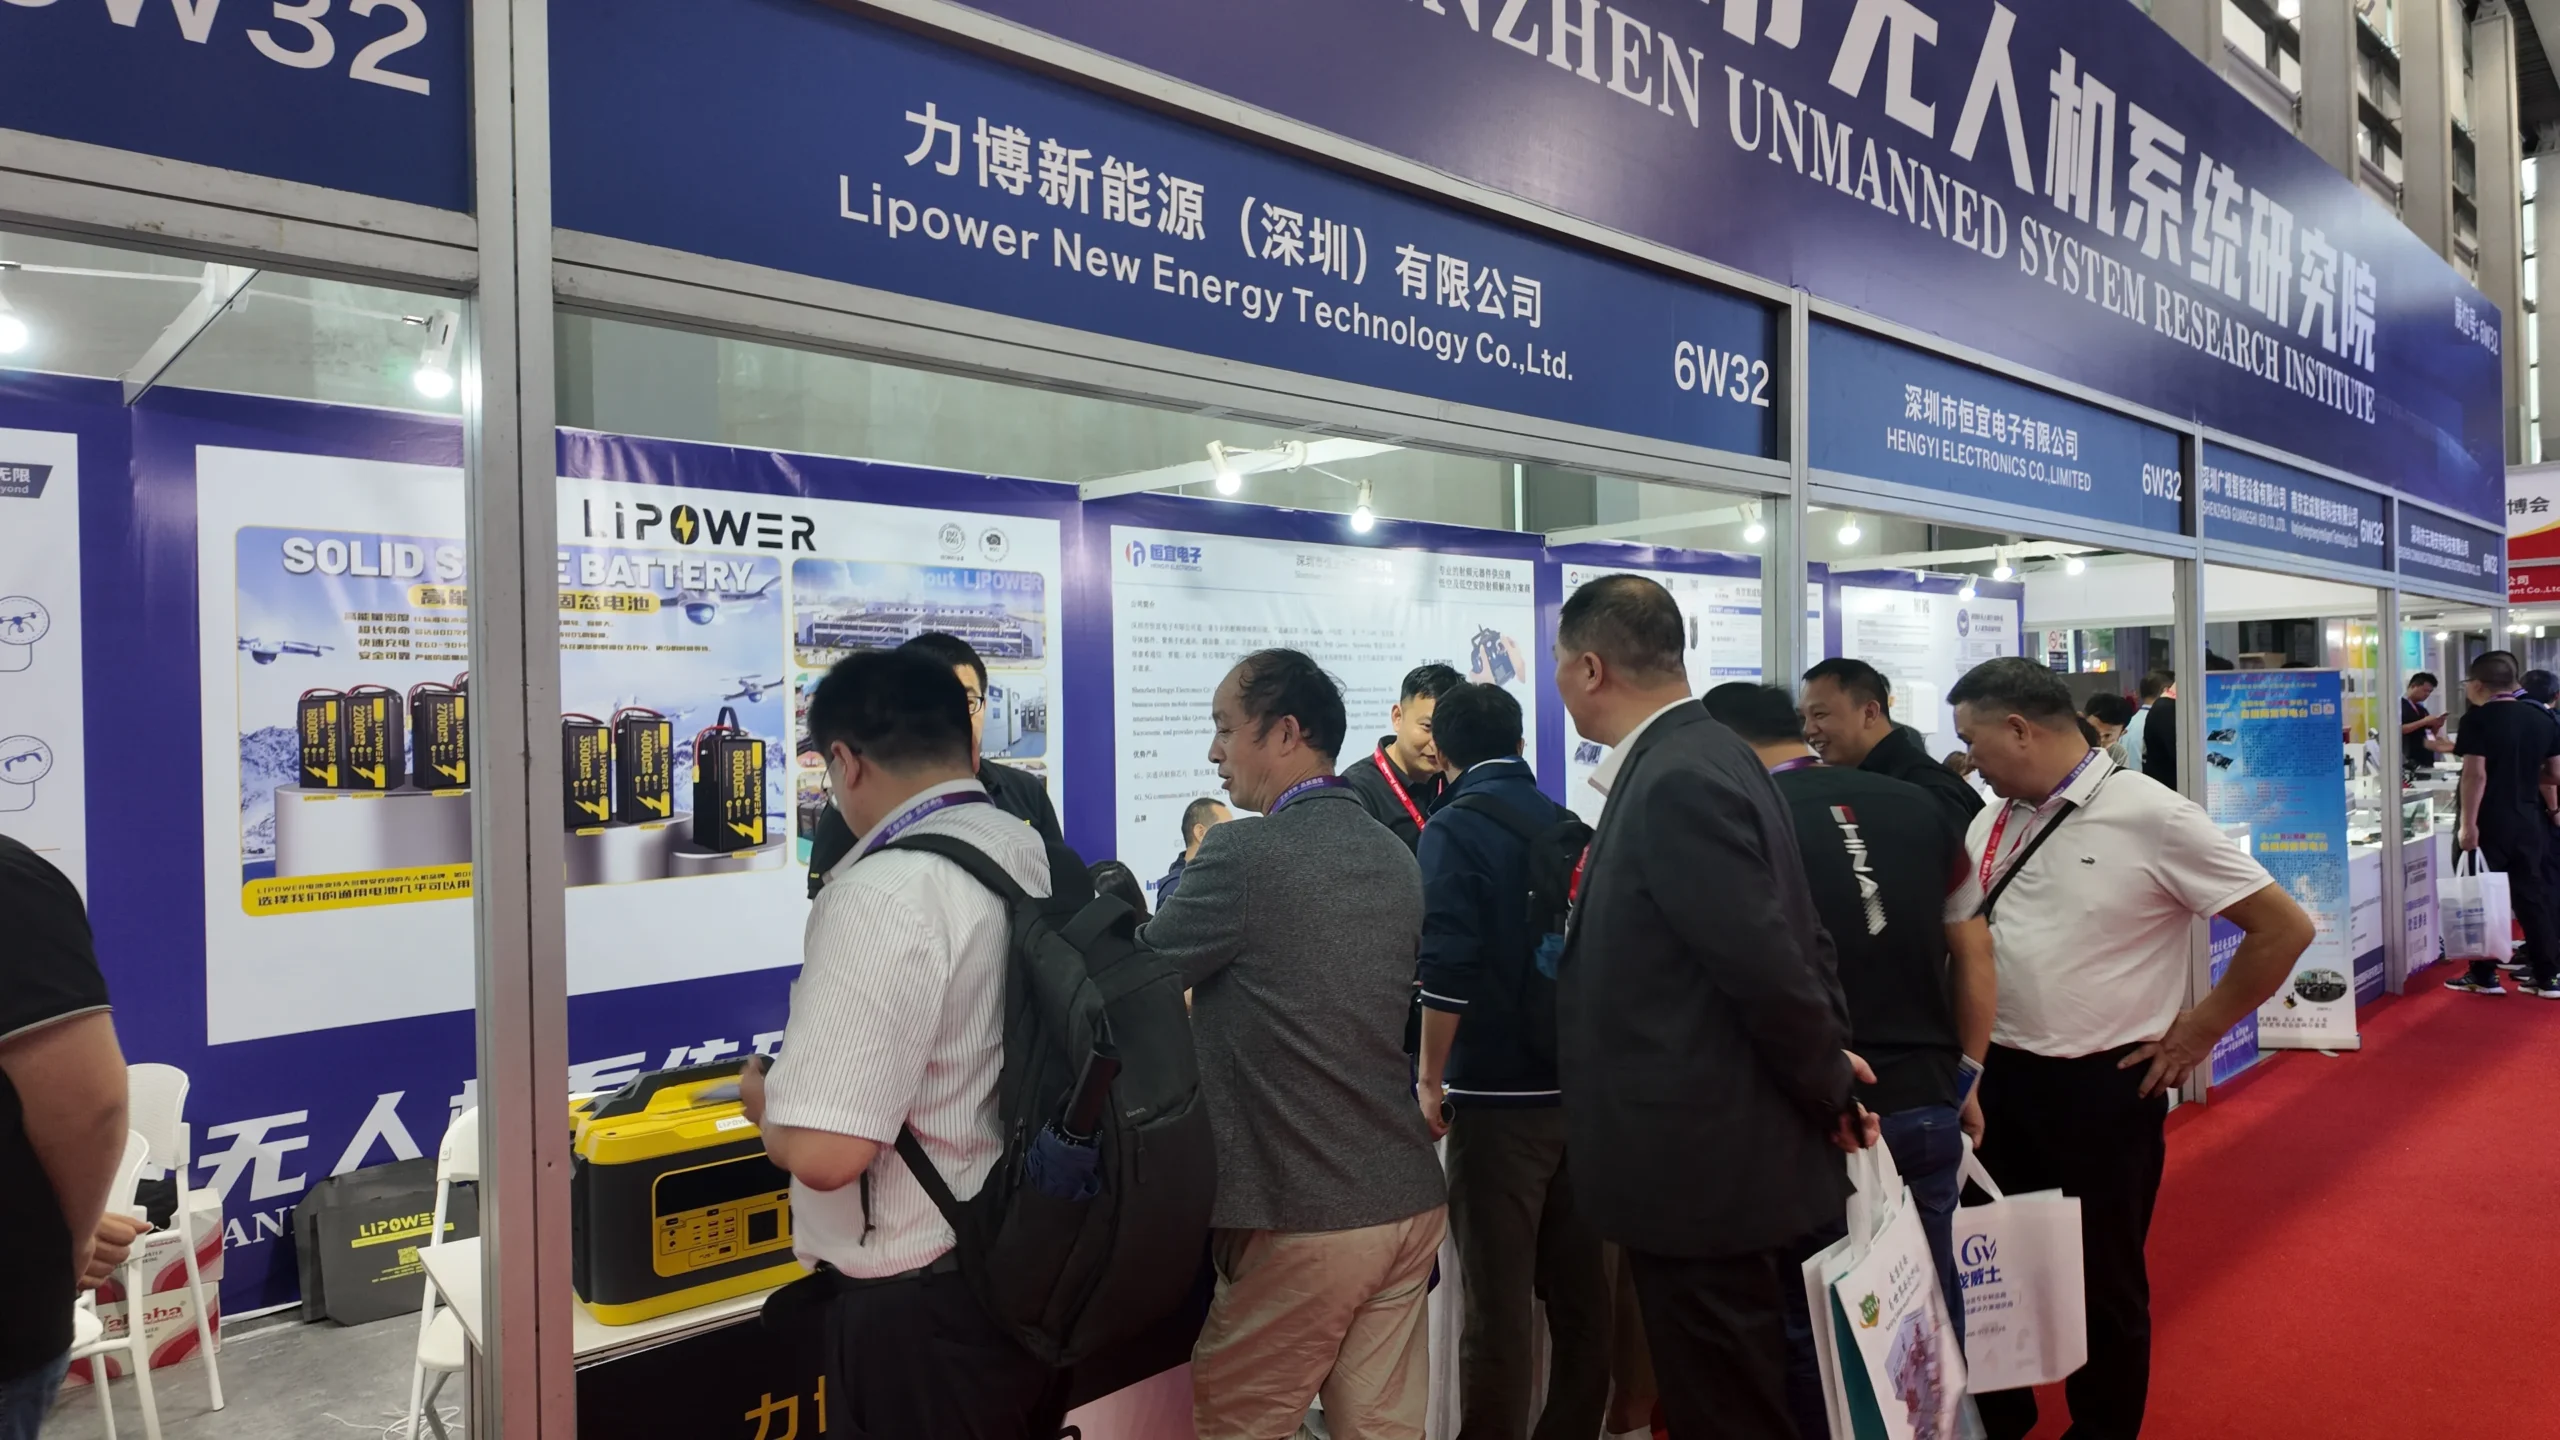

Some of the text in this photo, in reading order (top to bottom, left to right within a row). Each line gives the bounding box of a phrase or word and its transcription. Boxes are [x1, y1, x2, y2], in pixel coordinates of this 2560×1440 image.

[904, 100, 1544, 329] 力博新能源（深圳）有限公司
[1723, 0, 2376, 373] 无人机系统研究院
[1724, 65, 2008, 260] UNMANNED
[2019, 214, 2145, 316] SYSTEM
[2153, 278, 2281, 382] RESEARCH
[2284, 346, 2377, 427] INSTITUTE
[838, 174, 1575, 383] Lipower New Energy Technology Co.,Ltd.
[1673, 338, 1770, 410] 6W32
[1904, 383, 2079, 462] 深圳市恒宜电子有限公司
[1887, 426, 2092, 493] HENGYI ELECTRONICS CO.,LIMITED
[2142, 462, 2183, 503] 6W32
[1149, 543, 1202, 564] 恒宜电子
[2360, 518, 2385, 547] 6W32
[281, 536, 425, 579] SOLID
[580, 555, 755, 593] BATTERY
[358, 638, 411, 648] 快速充电
[358, 651, 411, 661] 安全可靠
[360, 1211, 435, 1237] LIPOWE
